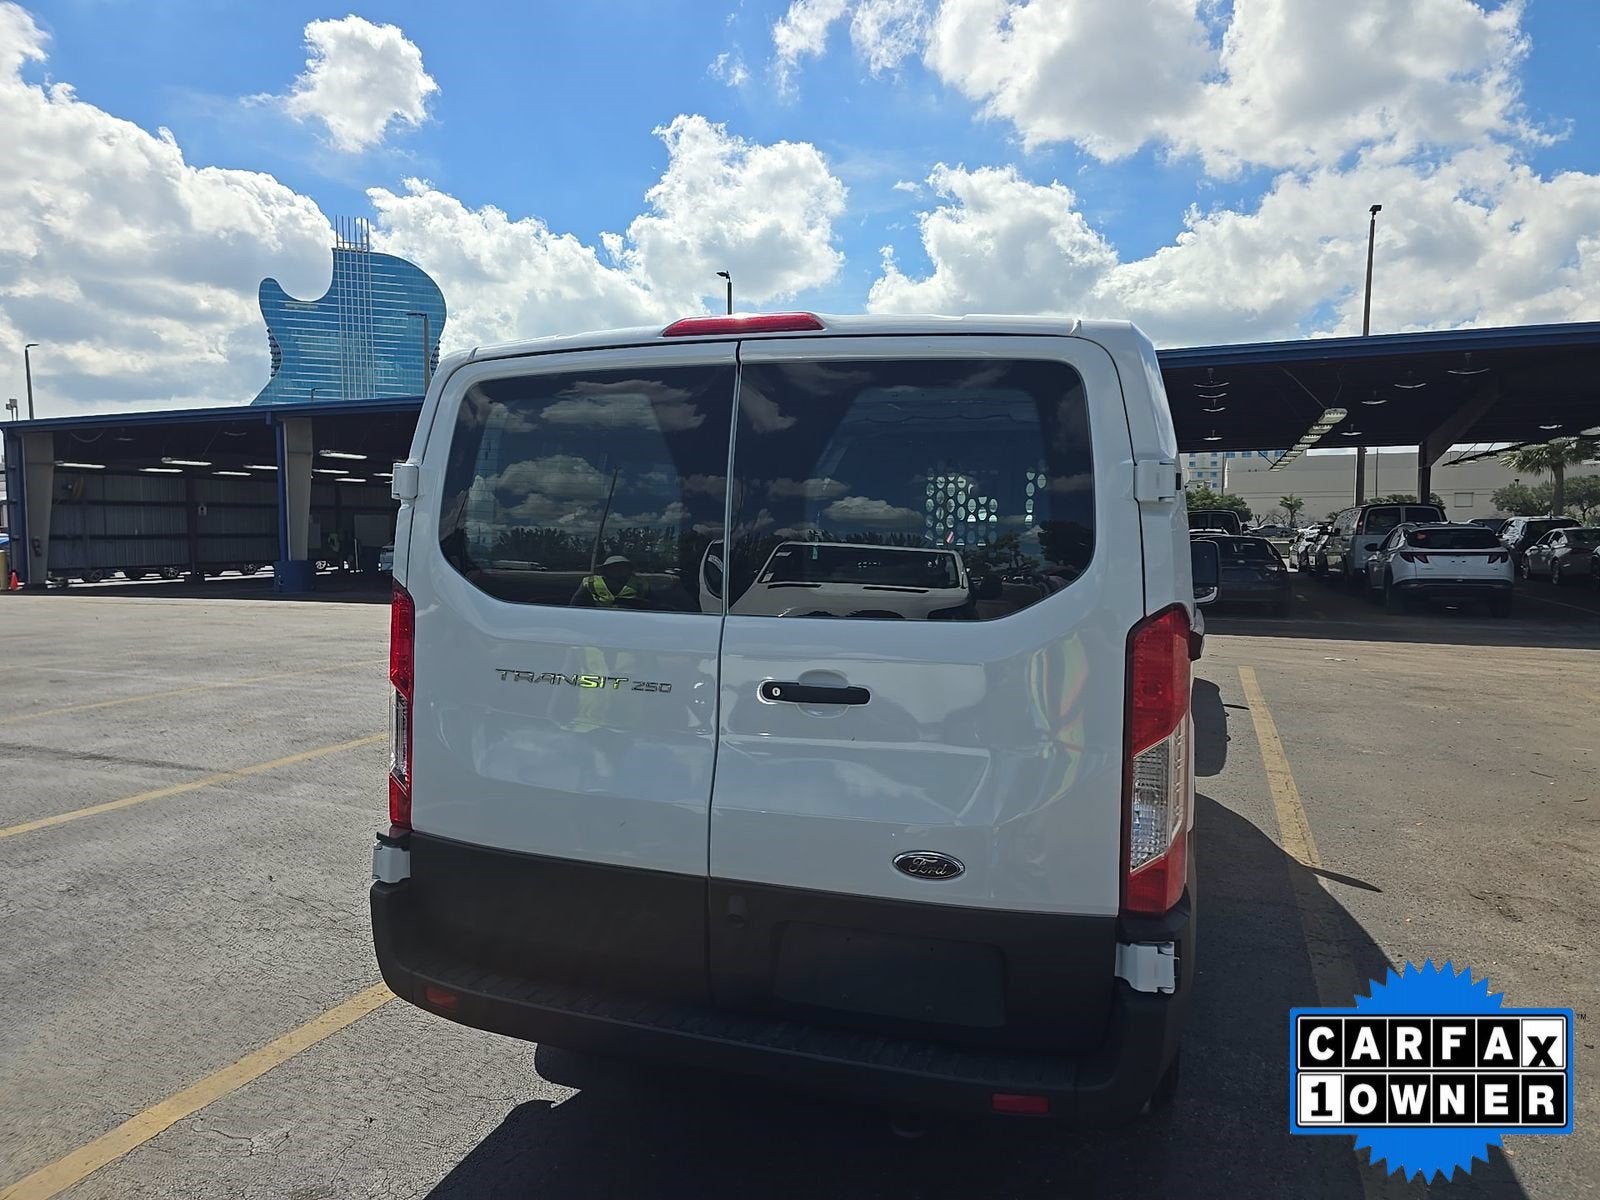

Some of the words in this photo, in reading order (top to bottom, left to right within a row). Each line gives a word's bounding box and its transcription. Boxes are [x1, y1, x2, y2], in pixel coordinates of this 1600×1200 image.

[495, 668, 629, 690] TRANSIT
[631, 680, 673, 694] 250
[908, 857, 948, 875] Ford
